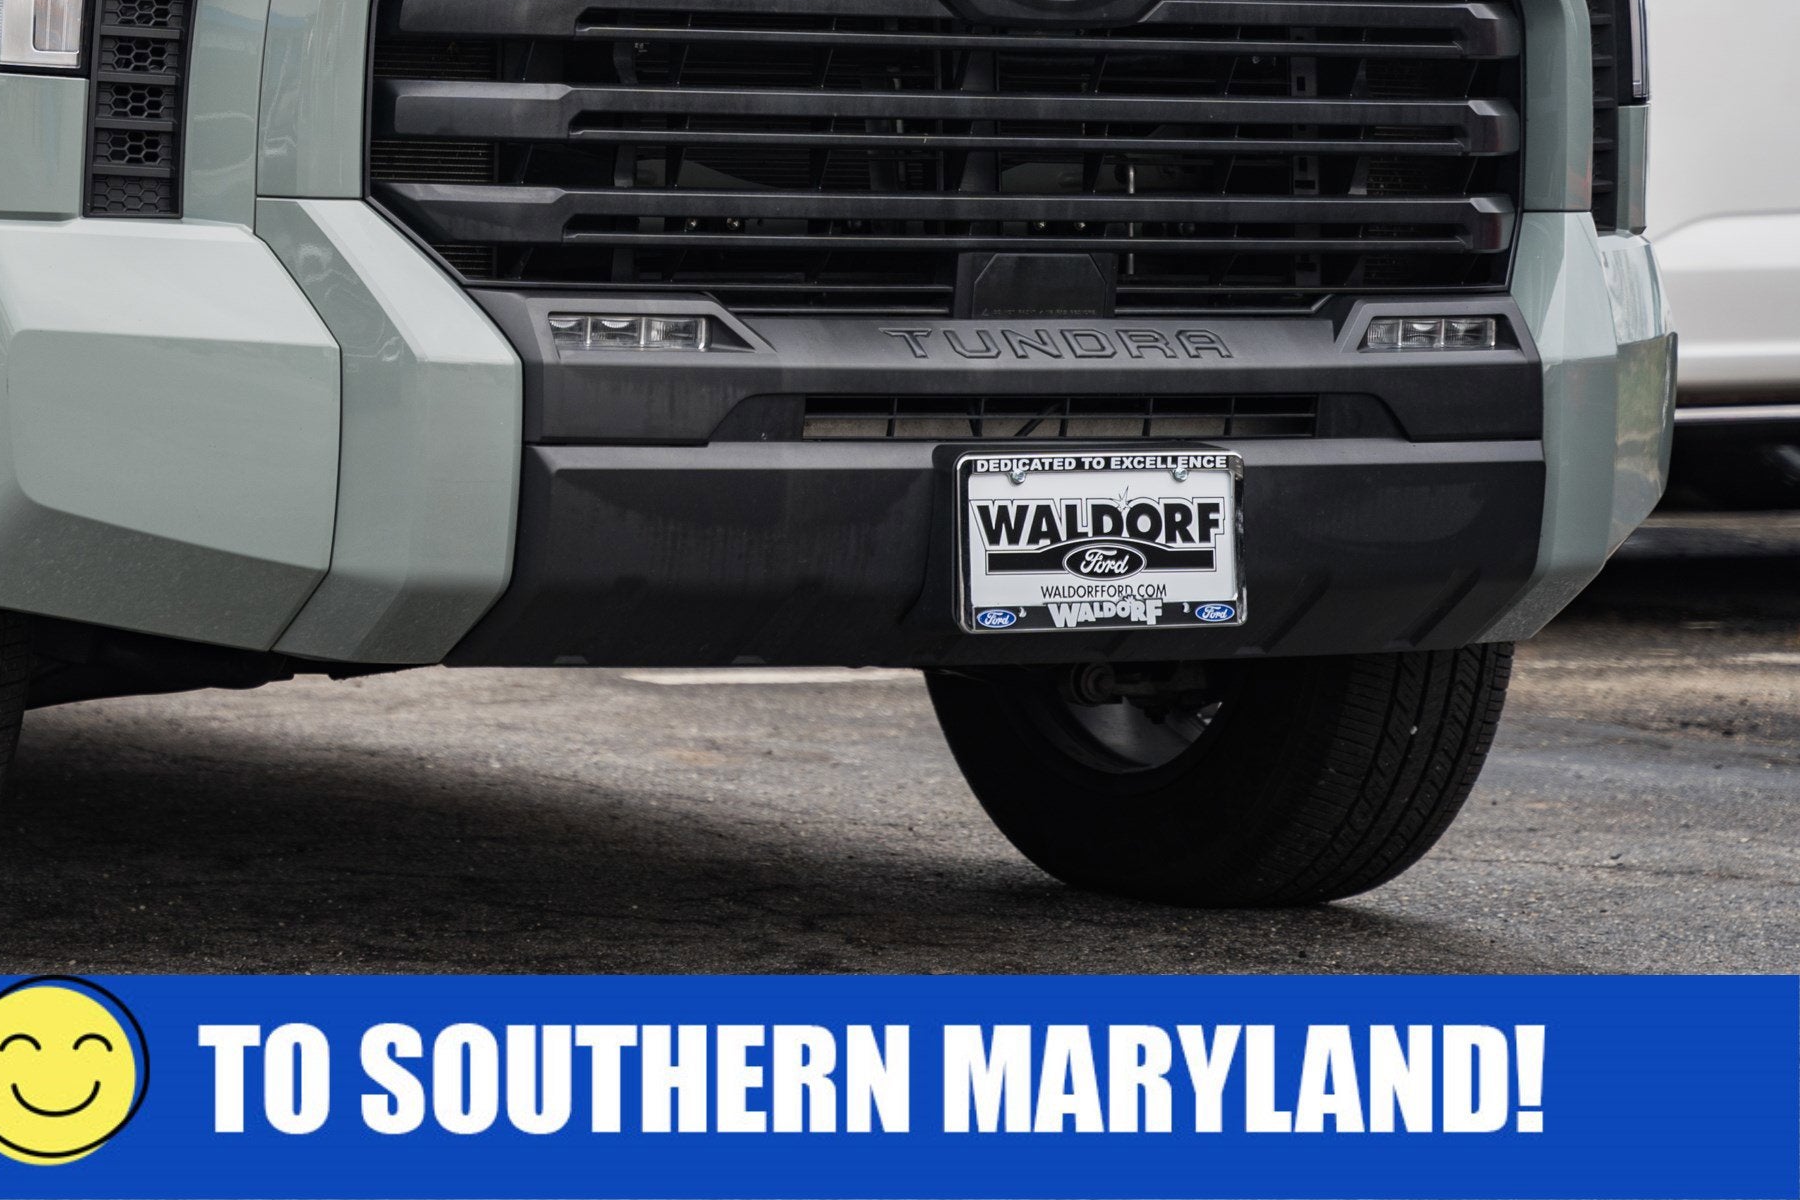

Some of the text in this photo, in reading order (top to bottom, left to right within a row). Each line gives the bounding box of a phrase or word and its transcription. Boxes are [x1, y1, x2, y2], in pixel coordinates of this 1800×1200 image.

[879, 328, 1233, 359] TUNDRA
[975, 455, 1227, 473] DEDICATED TO EXCELLENCE
[974, 501, 1223, 546] WALDORF
[1080, 549, 1130, 575] Ford
[984, 611, 1010, 626] Ford
[1049, 599, 1163, 628] WALDORF
[1200, 605, 1228, 620] Ford
